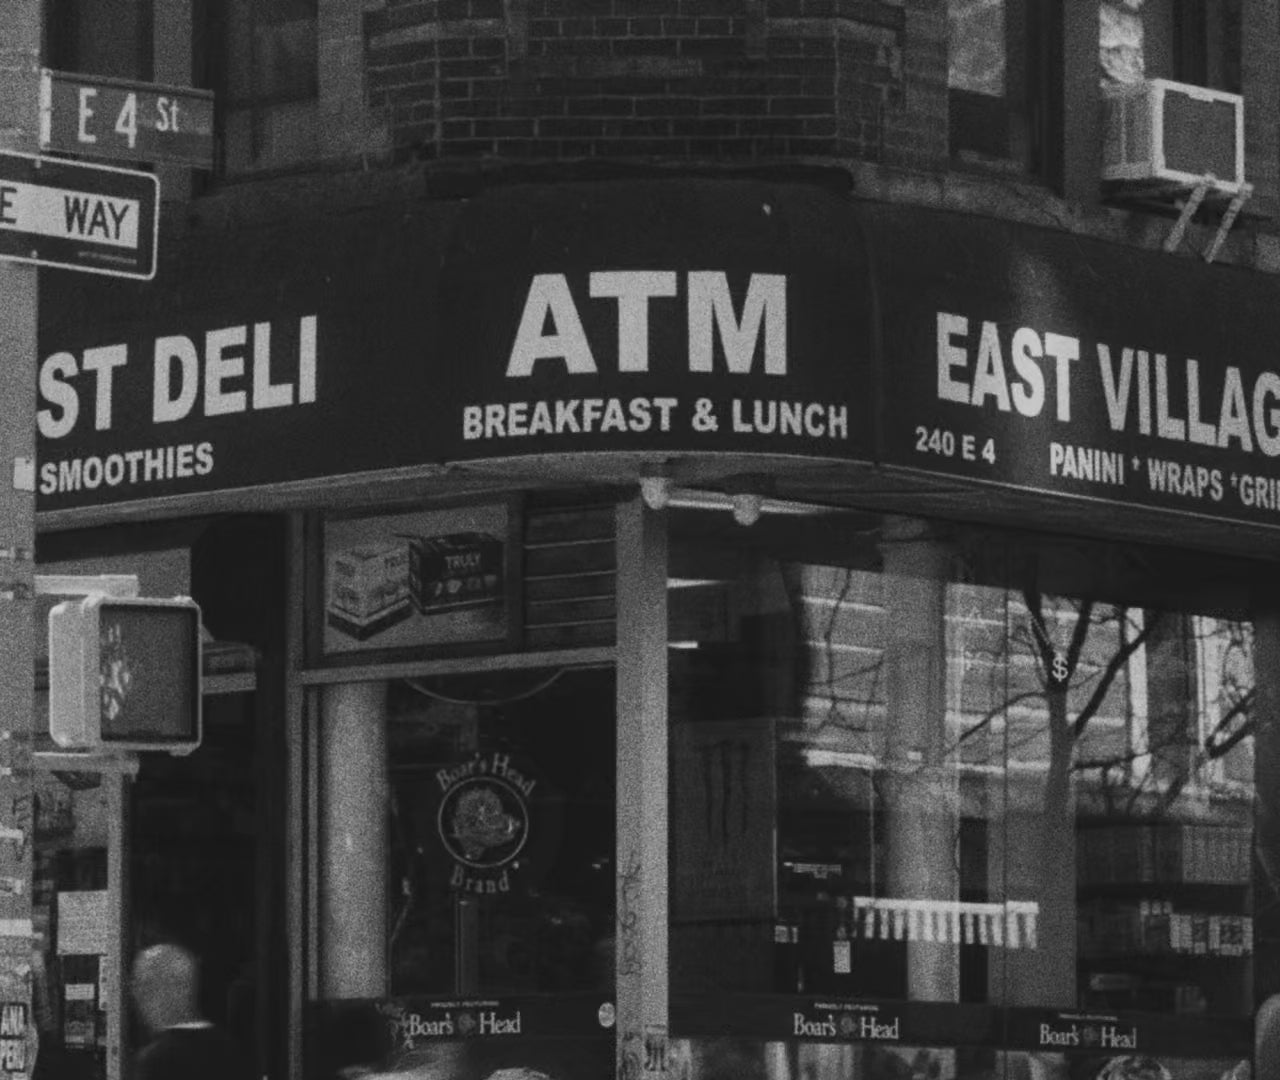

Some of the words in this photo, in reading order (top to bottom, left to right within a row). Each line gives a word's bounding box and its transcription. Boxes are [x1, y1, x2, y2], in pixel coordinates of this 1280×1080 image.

[78, 87, 97, 144] E
[114, 92, 138, 148] 4
[155, 95, 180, 133] St
[63, 195, 129, 241] WAY
[505, 269, 787, 378] ATM
[152, 314, 318, 424] DELI
[936, 311, 1081, 424] EAST
[462, 396, 678, 440] BREAKFAST
[690, 397, 720, 433] &
[732, 397, 849, 440] LUNCH
[915, 425, 955, 458] 240
[962, 435, 977, 462] E
[981, 438, 997, 465] 4
[38, 442, 214, 496] SMOOTHIES
[1049, 441, 1125, 486] PANINI
[1147, 457, 1224, 502] WRAPS
[436, 752, 487, 793] Boar's
[490, 752, 537, 797] Head
[450, 865, 510, 893] Brand
[408, 1011, 454, 1036] Boar's
[479, 1010, 522, 1035] Head
[793, 1012, 837, 1037] Boar's
[860, 1015, 900, 1040] Head
[1040, 1022, 1080, 1047] Boar's
[1101, 1026, 1137, 1049] Head
